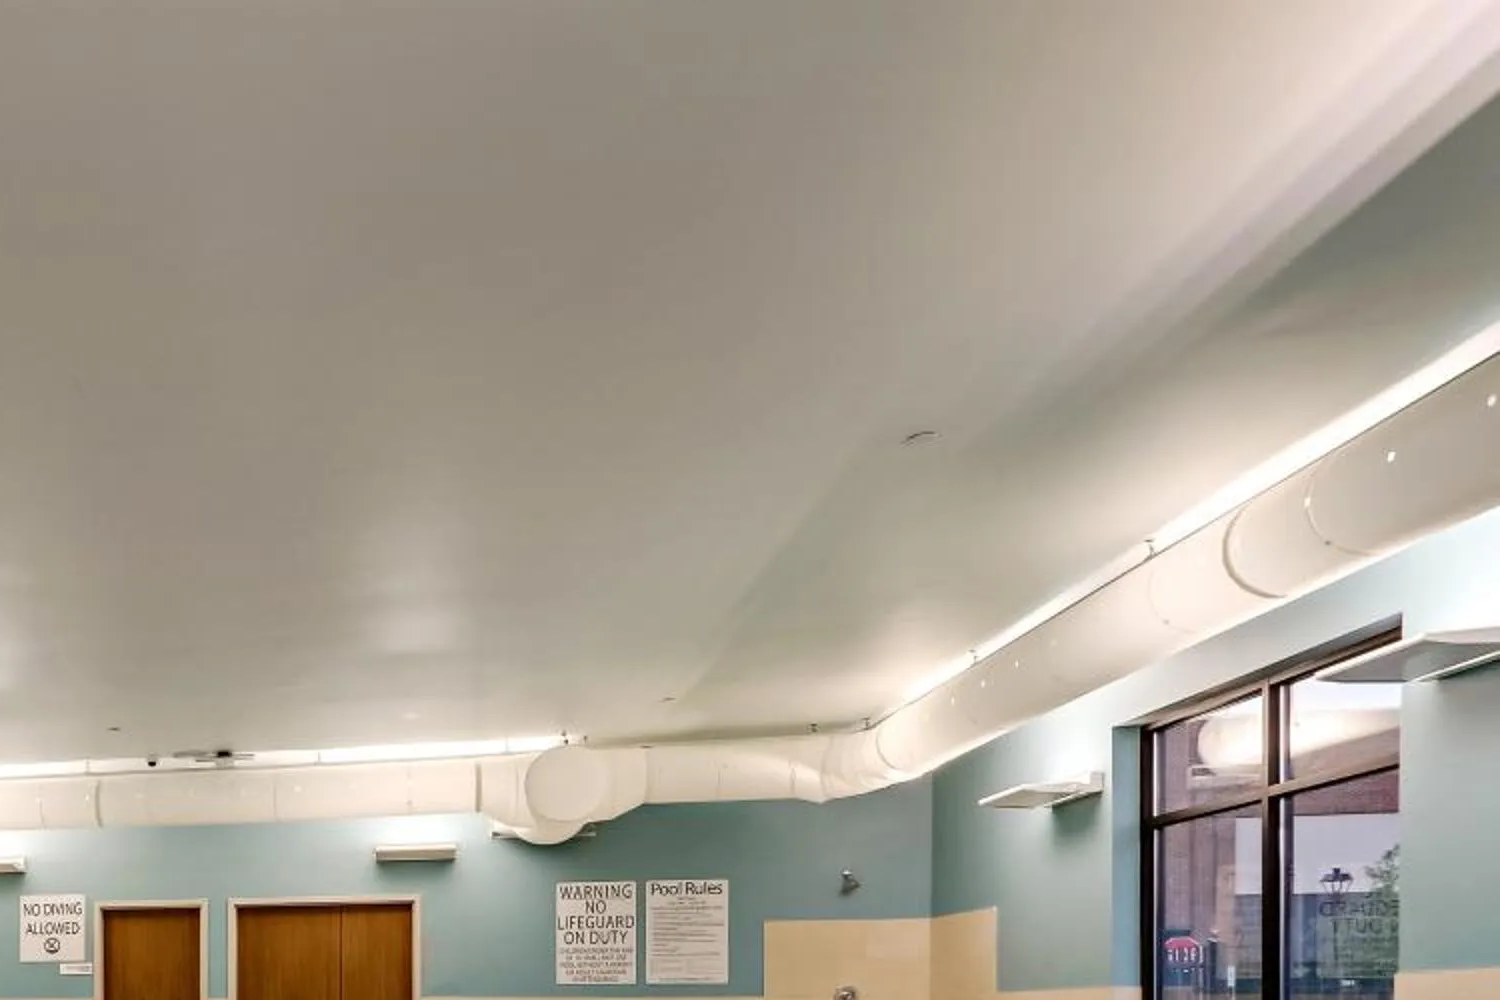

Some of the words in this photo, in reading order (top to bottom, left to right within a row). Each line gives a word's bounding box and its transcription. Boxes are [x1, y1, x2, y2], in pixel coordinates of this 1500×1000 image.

[560, 884, 633, 899] WARNING
[651, 882, 682, 895] Pool
[686, 882, 723, 895] Rules
[23, 903, 41, 916] NO
[44, 901, 83, 916] DIVING
[585, 900, 606, 914] NO
[26, 922, 81, 935] ALLOWED
[558, 916, 635, 930] LIFEGUARD
[564, 931, 584, 944] ON
[590, 930, 628, 944] DUTY
